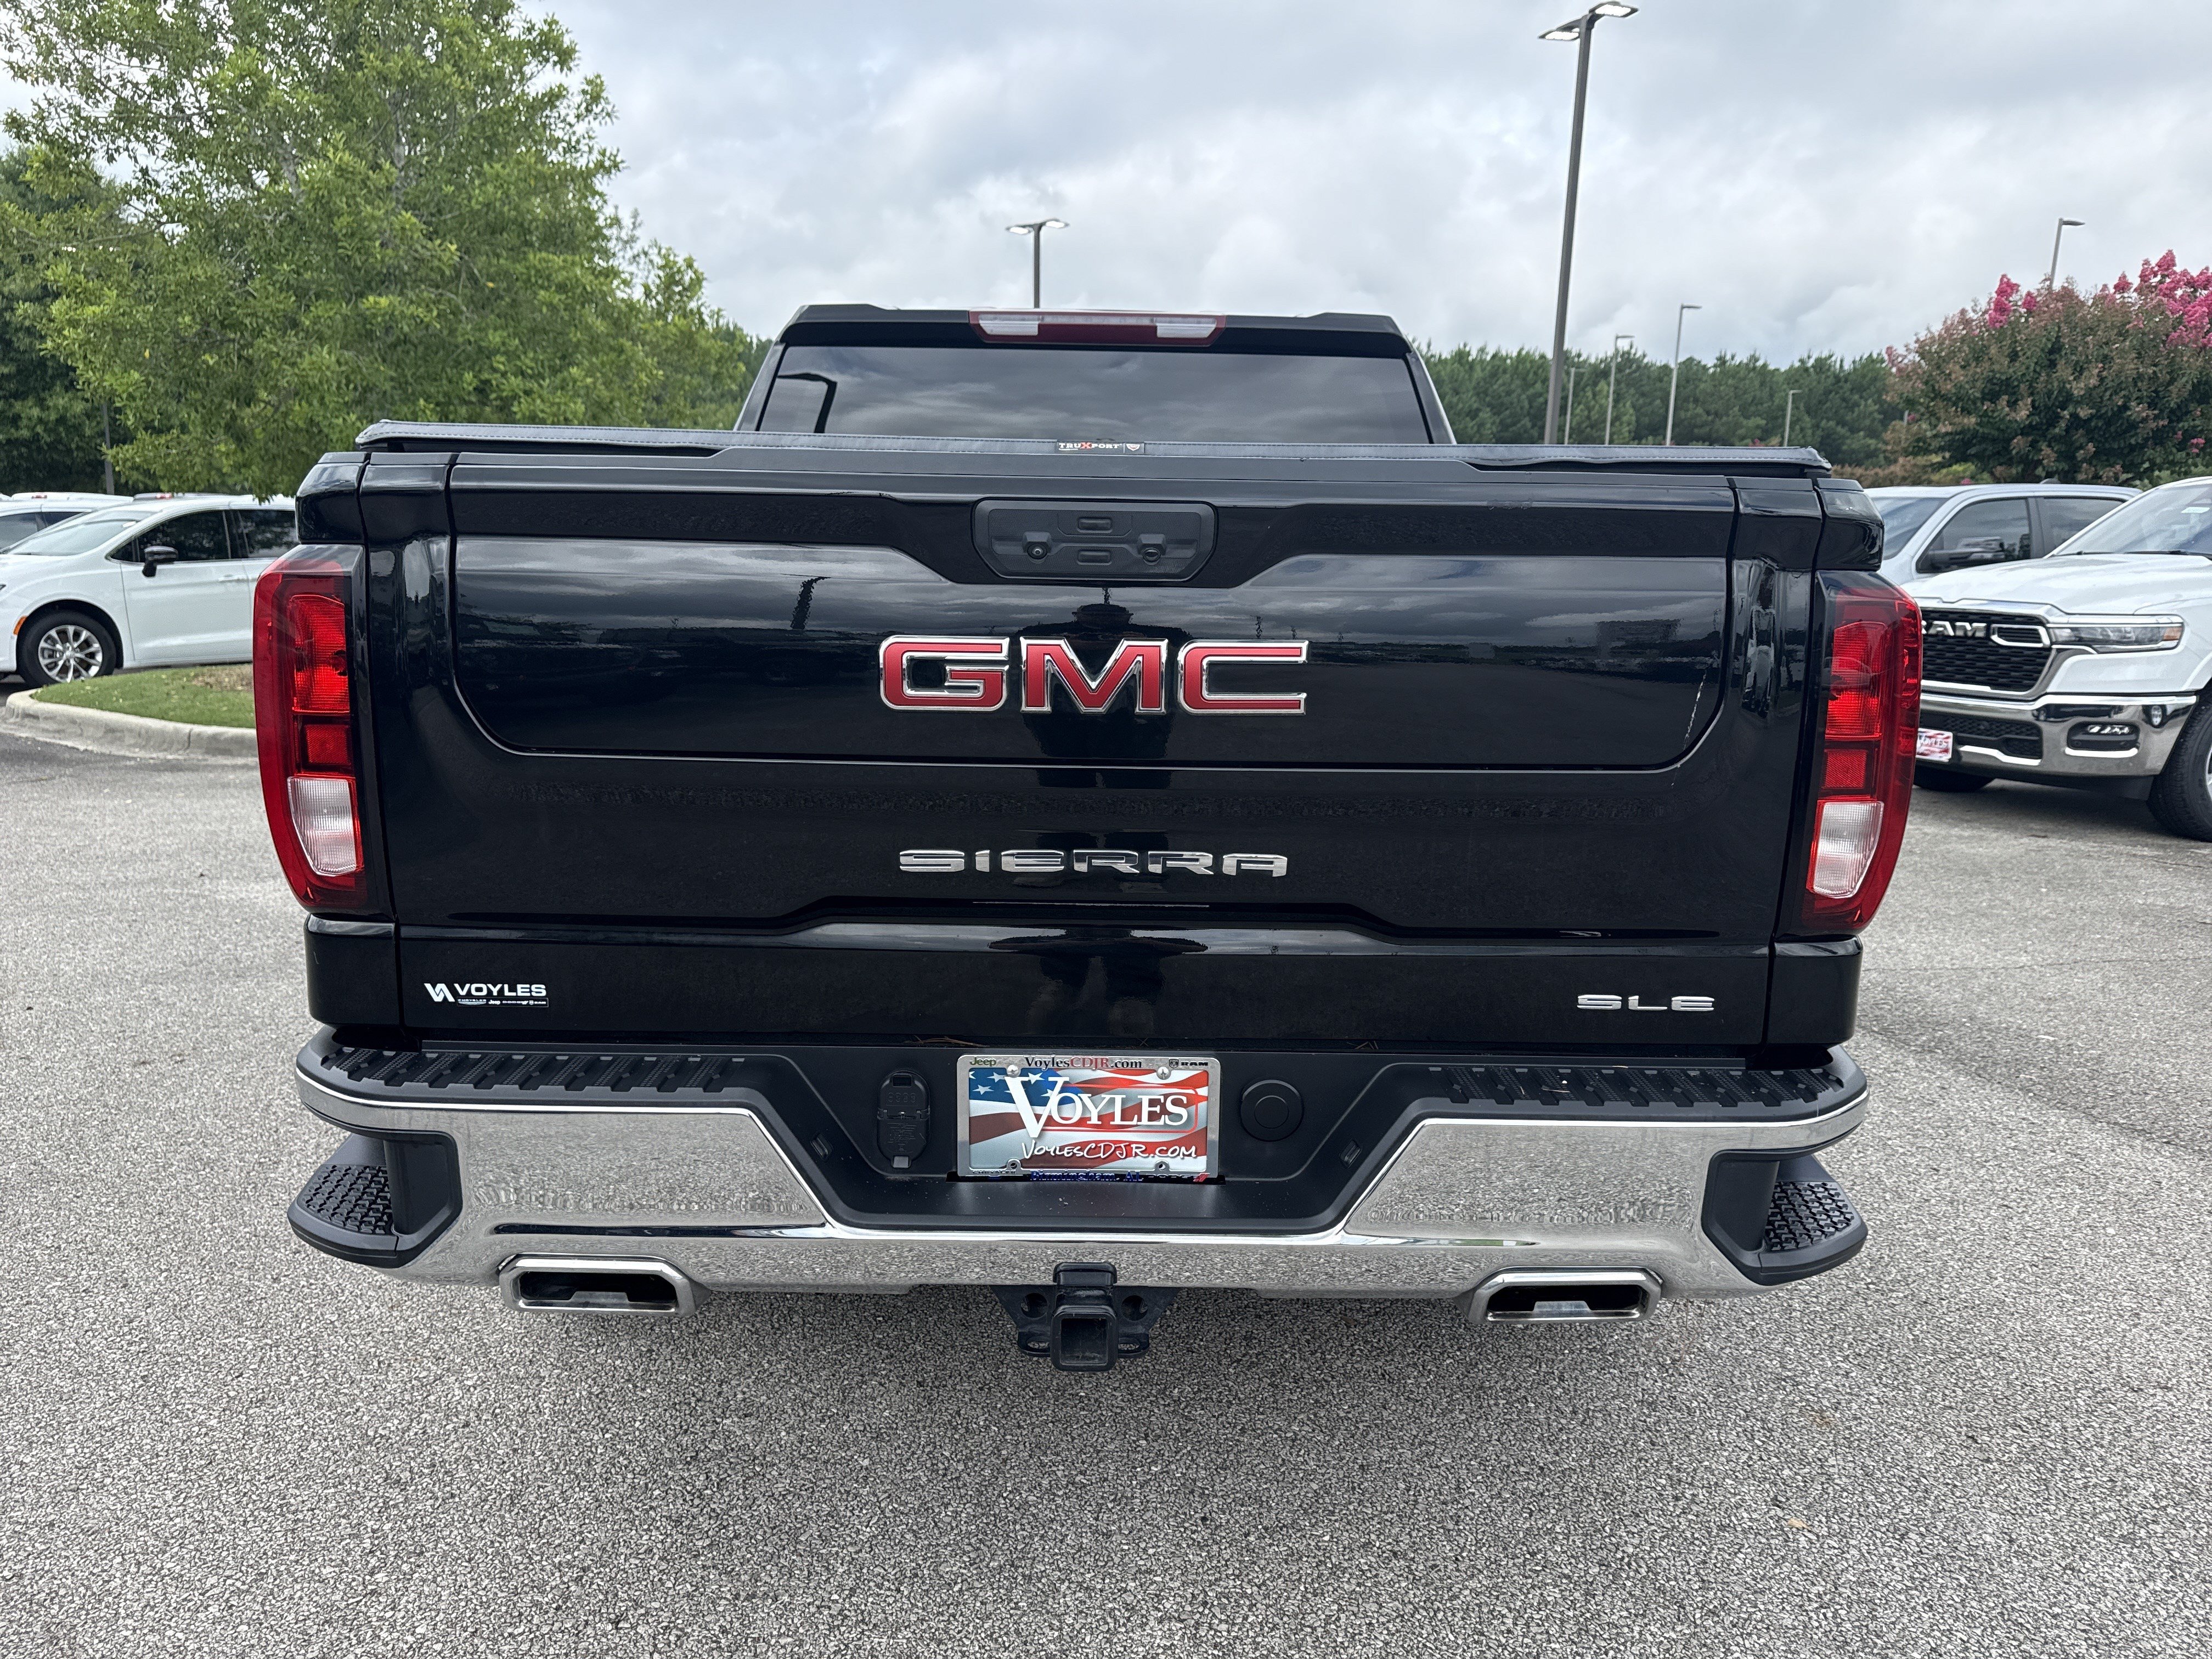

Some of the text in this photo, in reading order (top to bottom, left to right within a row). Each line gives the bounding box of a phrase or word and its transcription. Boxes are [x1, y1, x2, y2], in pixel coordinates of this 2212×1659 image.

[1921, 620, 1987, 637] AM
[879, 635, 1308, 715] GMC
[899, 849, 1288, 877] SIERRA
[454, 984, 546, 996] VOYLES
[1577, 994, 1715, 1011] SLE
[969, 1057, 996, 1066] Jeep
[1024, 1056, 1142, 1070] VoylesCDJR.com
[1004, 1076, 1188, 1138] VOYLES
